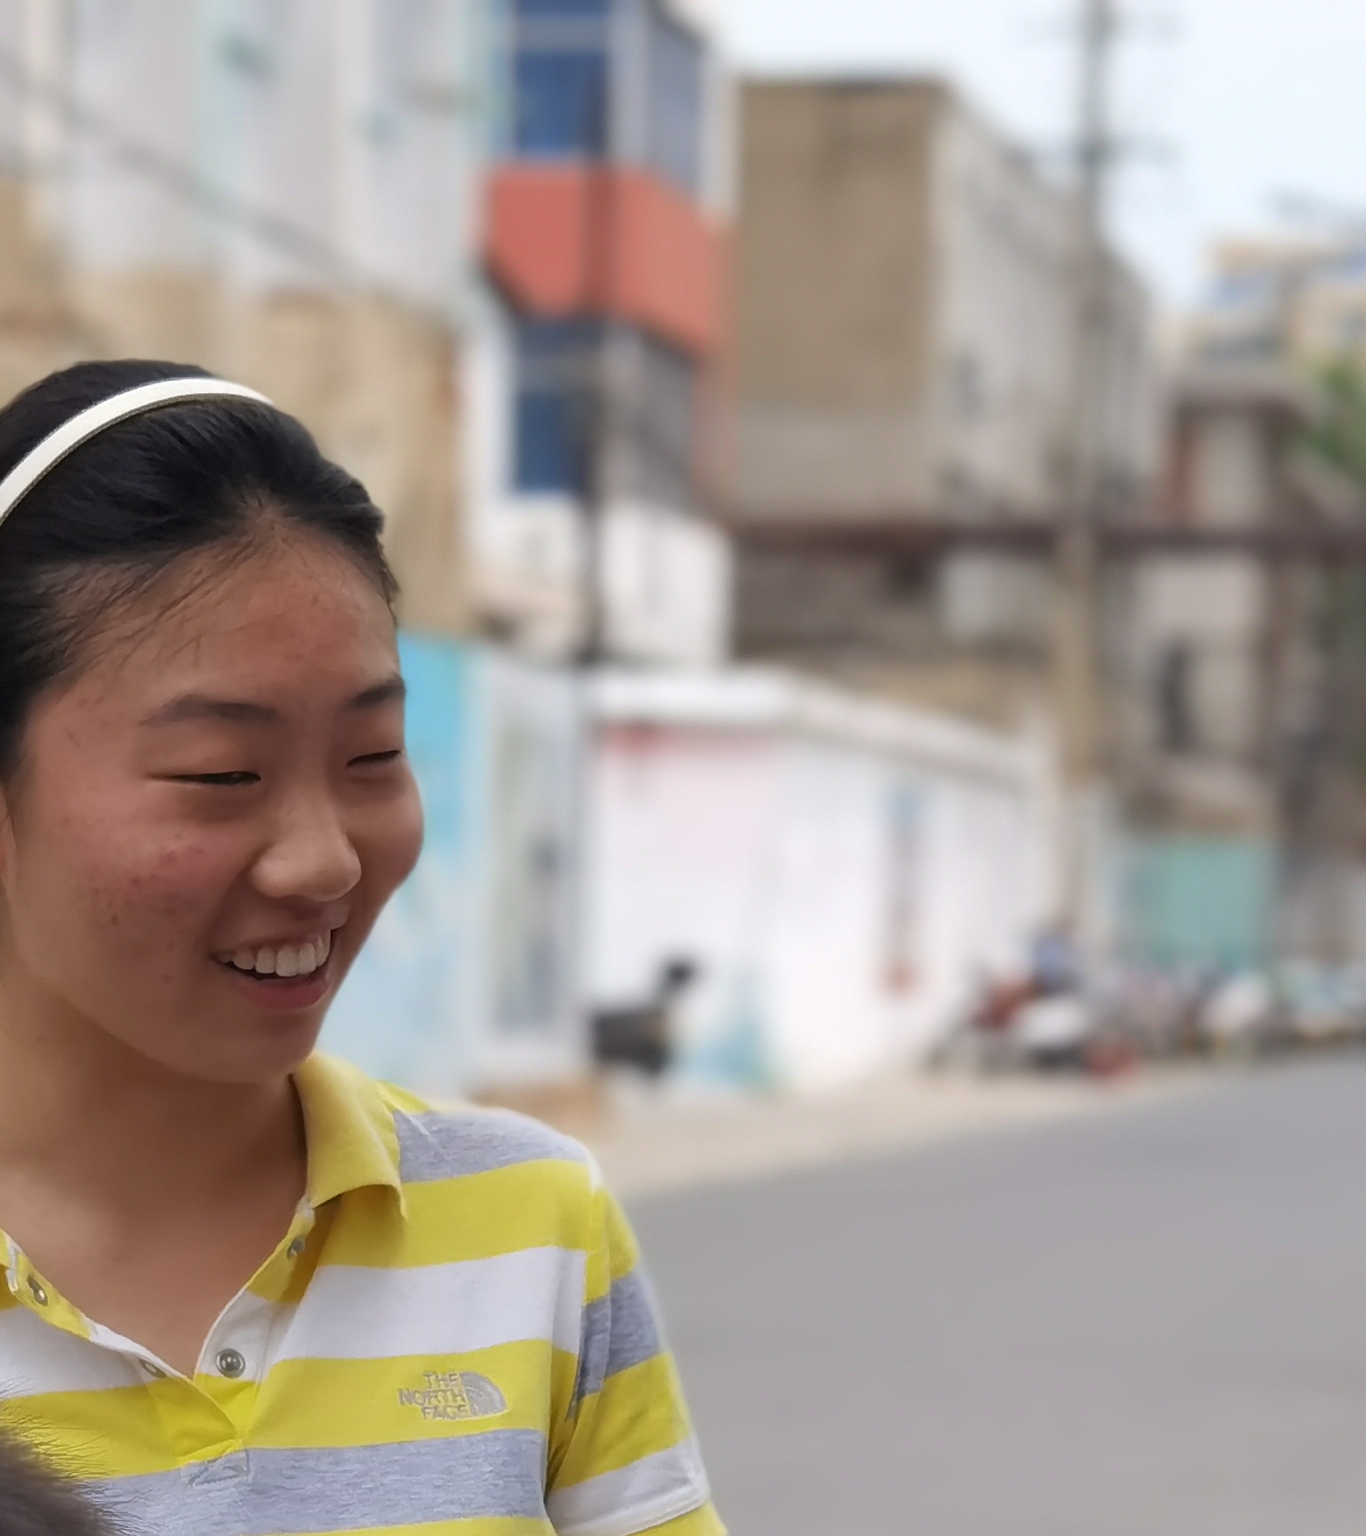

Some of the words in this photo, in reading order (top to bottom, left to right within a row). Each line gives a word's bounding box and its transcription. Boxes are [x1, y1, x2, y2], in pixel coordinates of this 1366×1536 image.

[423, 1371, 461, 1388] THE
[398, 1388, 466, 1406] NORTH
[421, 1404, 469, 1420] FACE
